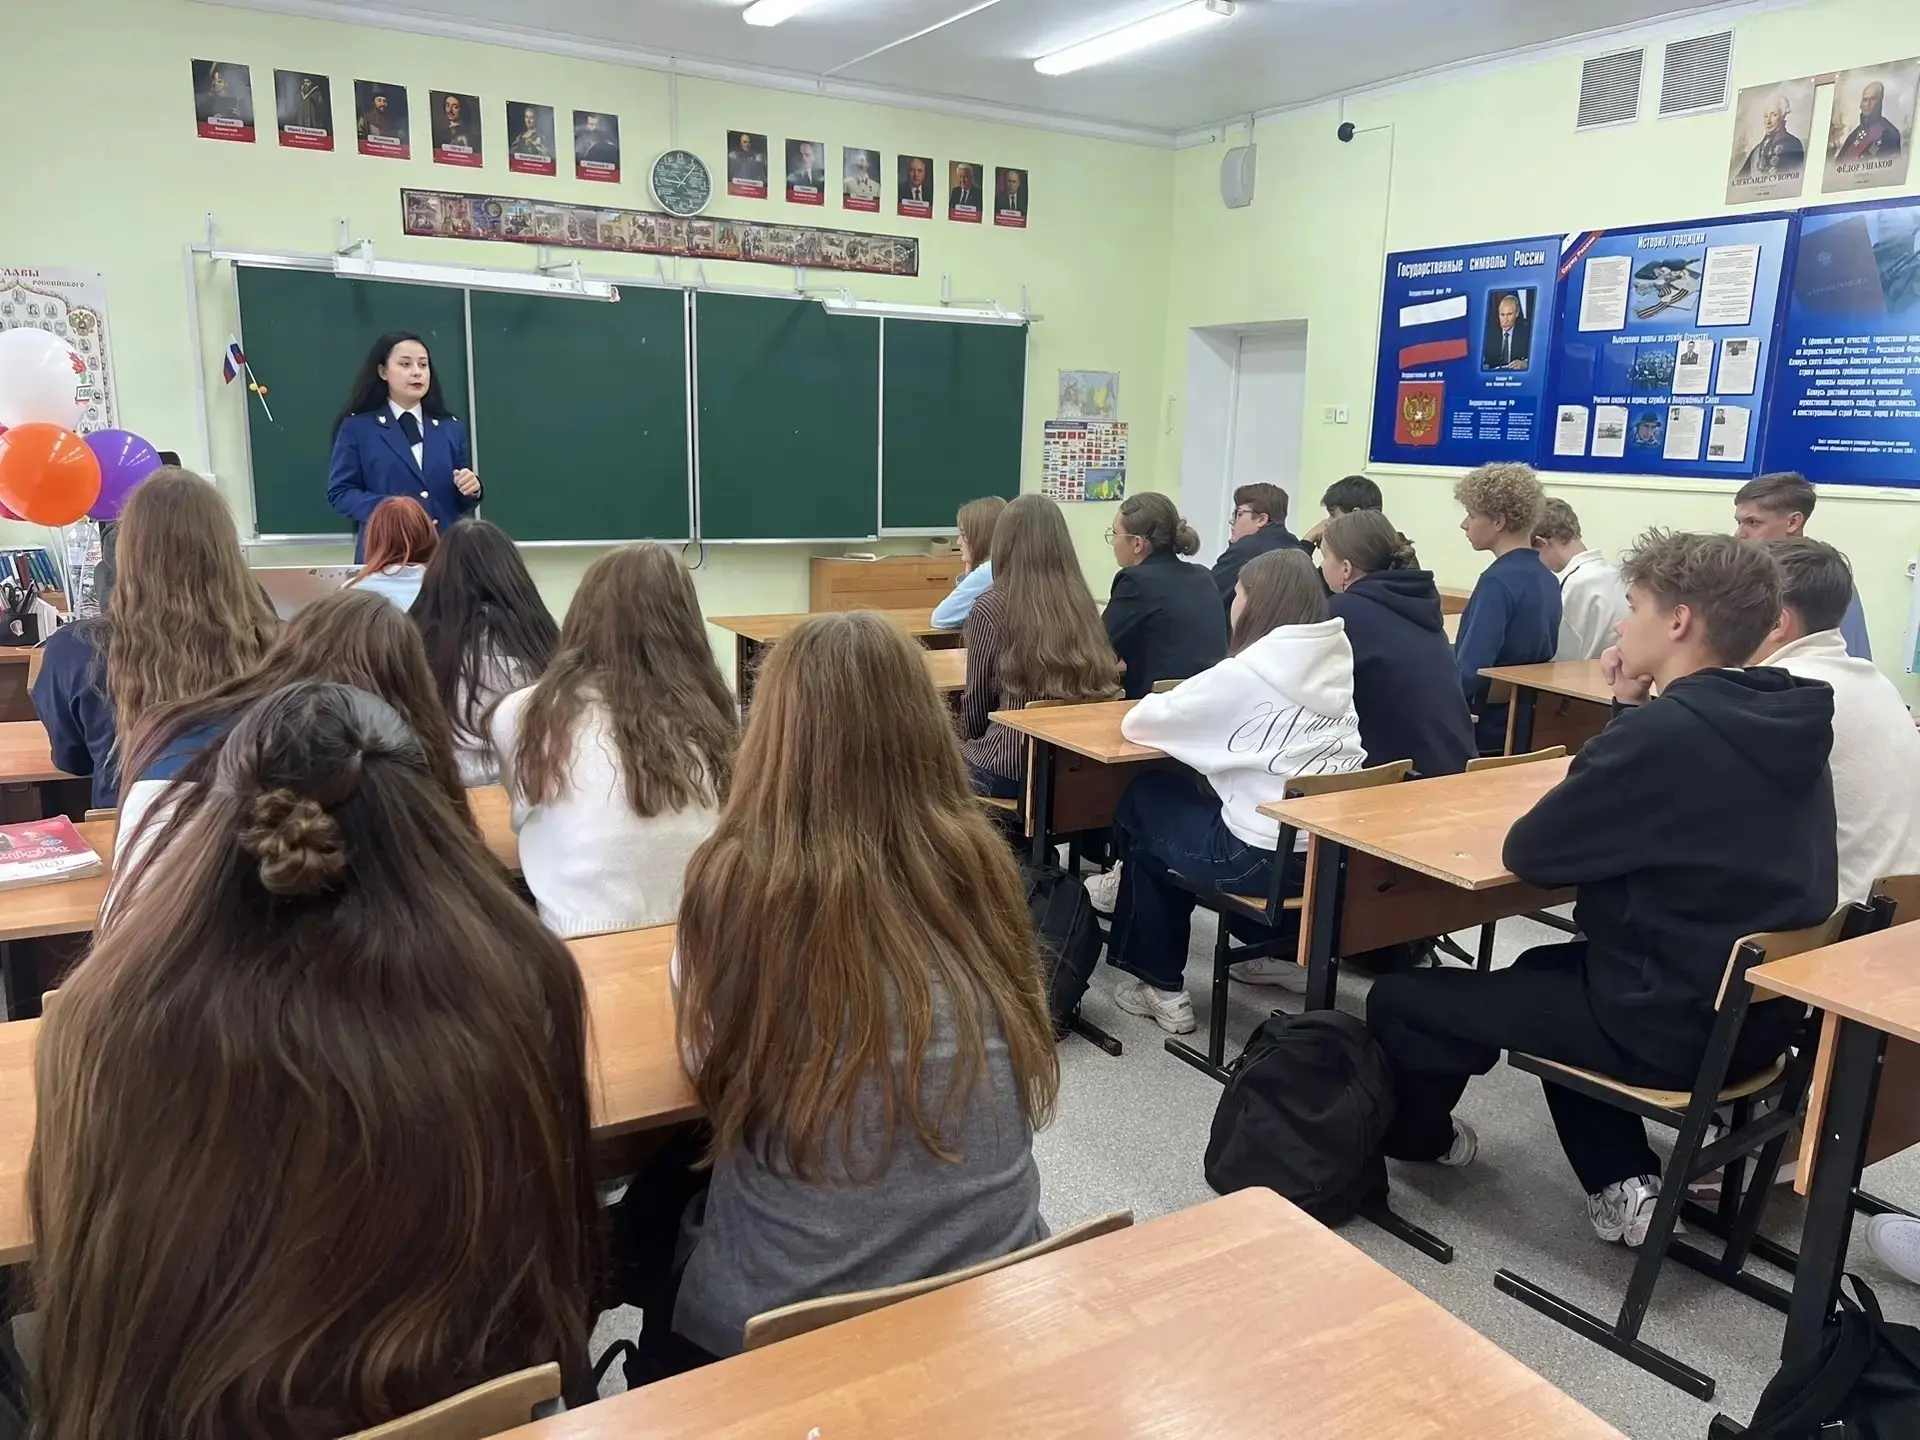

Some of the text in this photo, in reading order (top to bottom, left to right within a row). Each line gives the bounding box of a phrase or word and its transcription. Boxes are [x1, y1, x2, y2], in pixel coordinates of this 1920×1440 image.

[1836, 160, 1893, 173] ФЁДОР УШАКОВ
[1732, 172, 1800, 186] АЛЕКСАНДР СУВОРОВ
[1637, 232, 1706, 250] История, традиции
[1398, 250, 1545, 278] Государственные символы России
[32, 280, 84, 288] РОССИЙСКОГО
